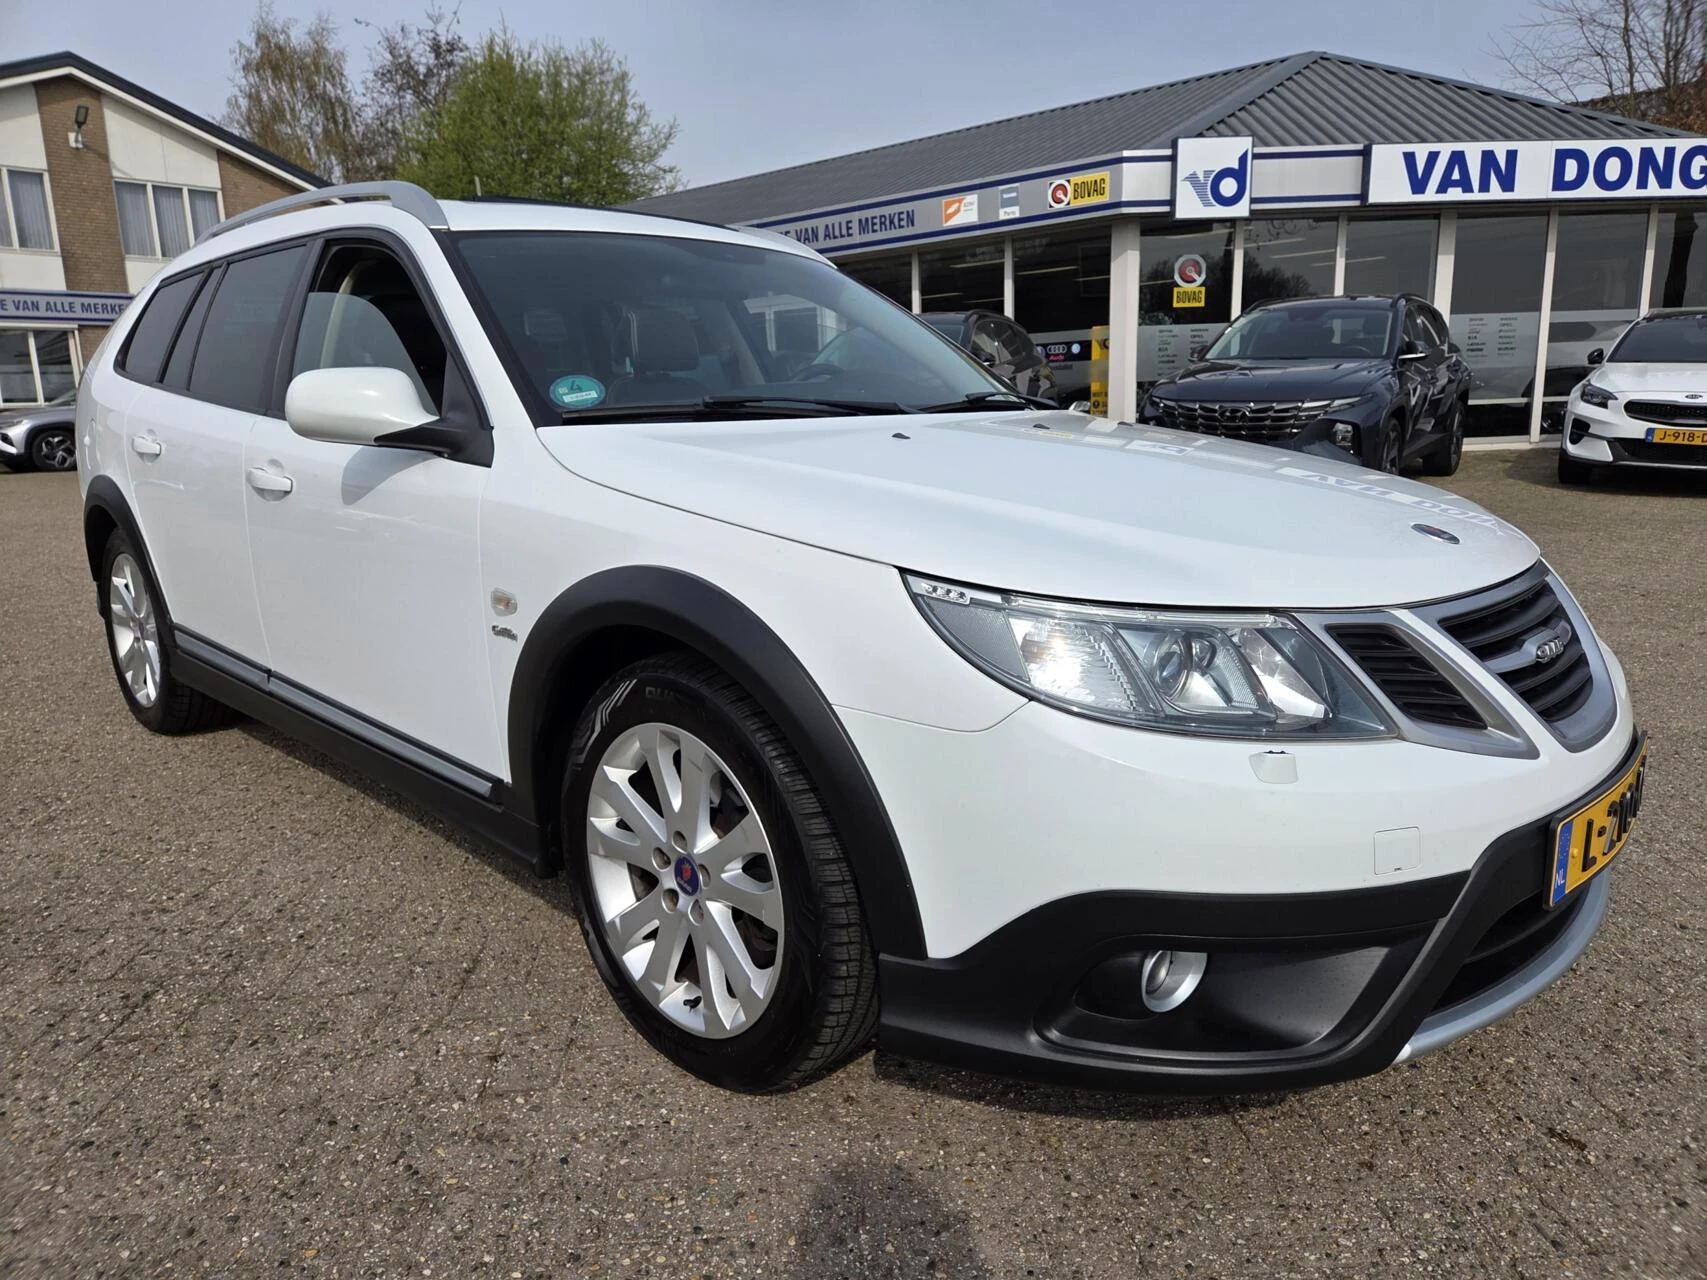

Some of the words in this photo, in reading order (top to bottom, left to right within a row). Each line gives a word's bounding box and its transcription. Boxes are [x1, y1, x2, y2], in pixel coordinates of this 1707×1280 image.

[1402, 149, 1518, 195] VAN
[1551, 145, 1707, 192] DONG
[1073, 178, 1105, 200] BOVAG
[795, 225, 819, 244] VAN
[823, 220, 853, 241] ALLE
[858, 209, 915, 235] MERKEN
[12, 299, 39, 312] VAN
[45, 301, 76, 313] ALLE
[1176, 291, 1202, 303] BOVAG
[1555, 870, 1566, 888] NL
